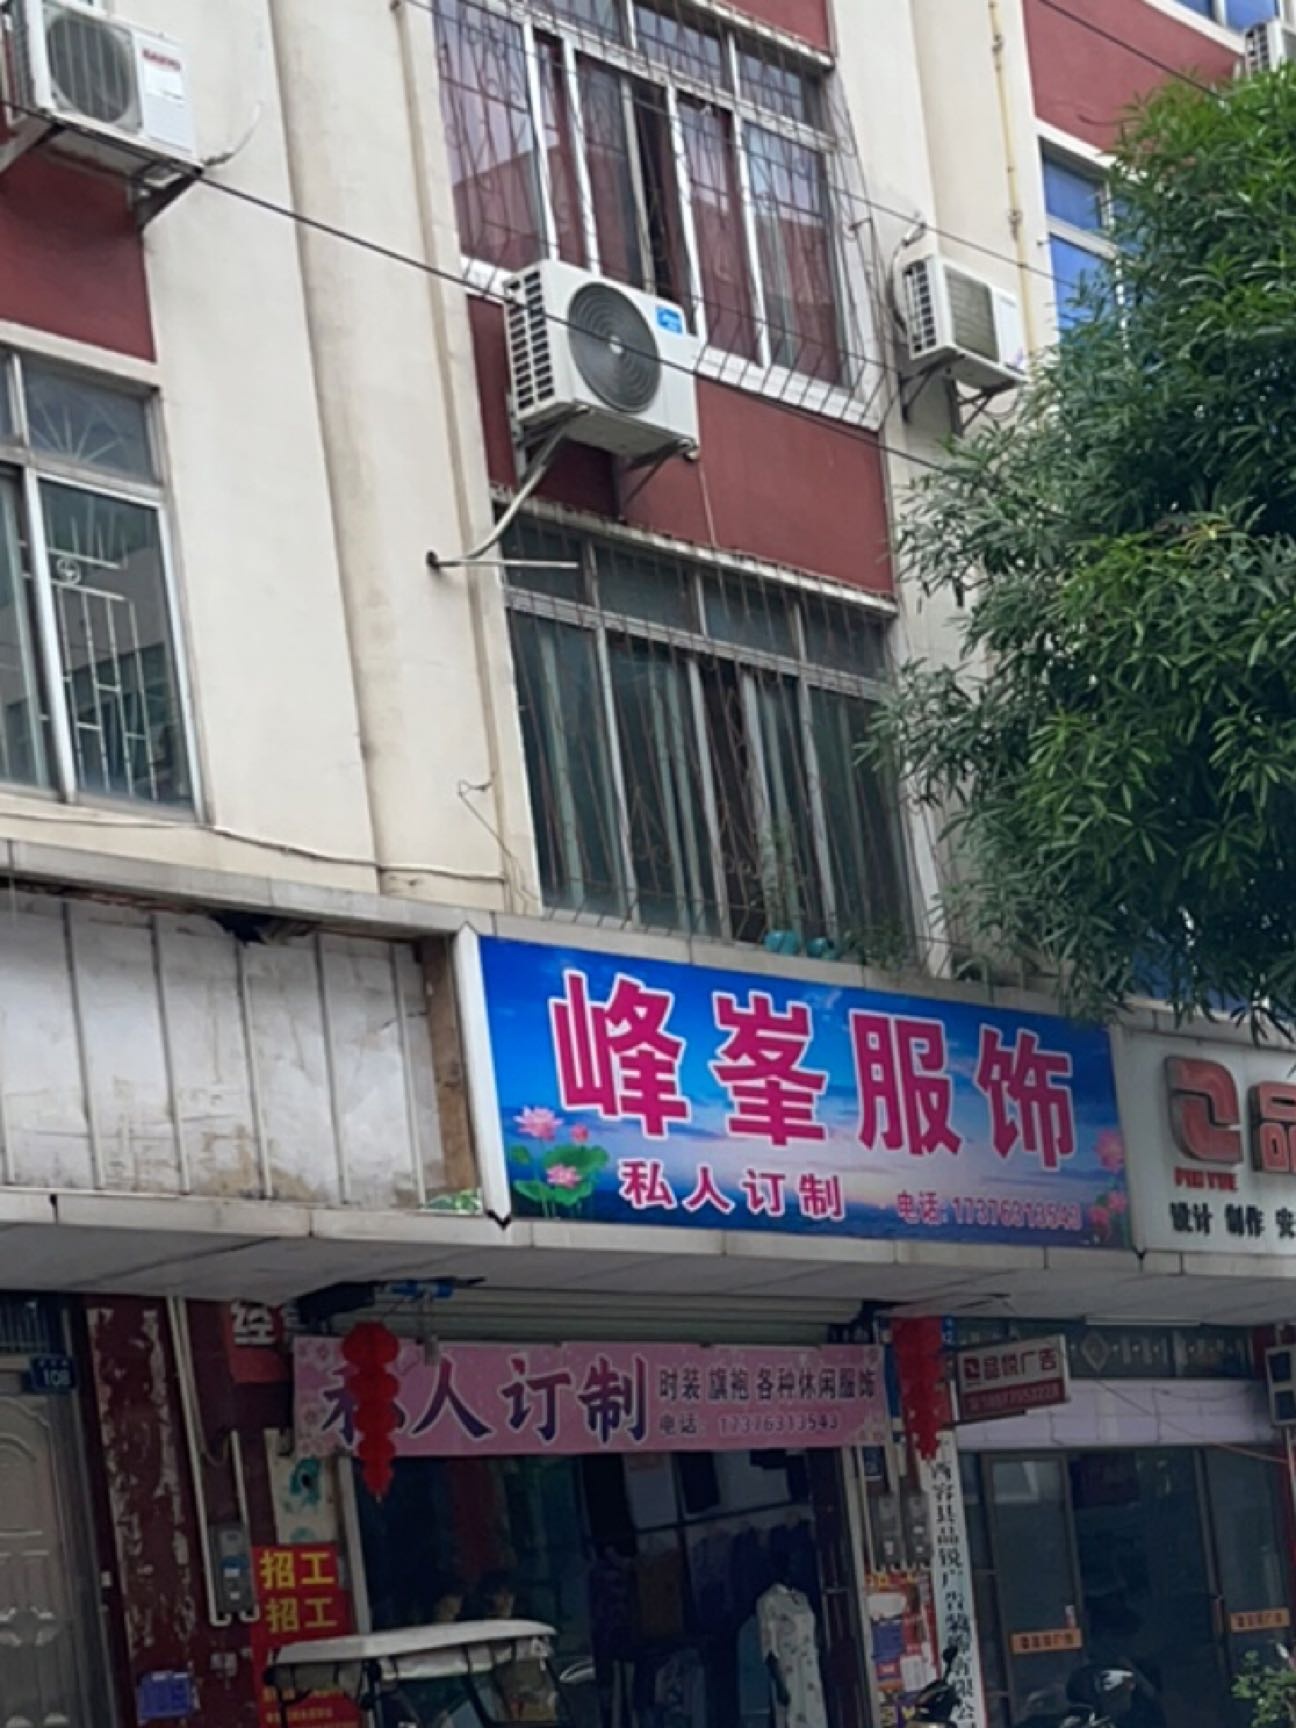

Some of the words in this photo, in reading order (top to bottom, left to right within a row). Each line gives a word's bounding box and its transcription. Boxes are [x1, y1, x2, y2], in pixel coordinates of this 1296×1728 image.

[620, 1161, 844, 1219] 私人订制
[659, 1368, 700, 1400] 时装
[258, 1549, 336, 1592] 招工
[264, 1597, 339, 1635] 招工
